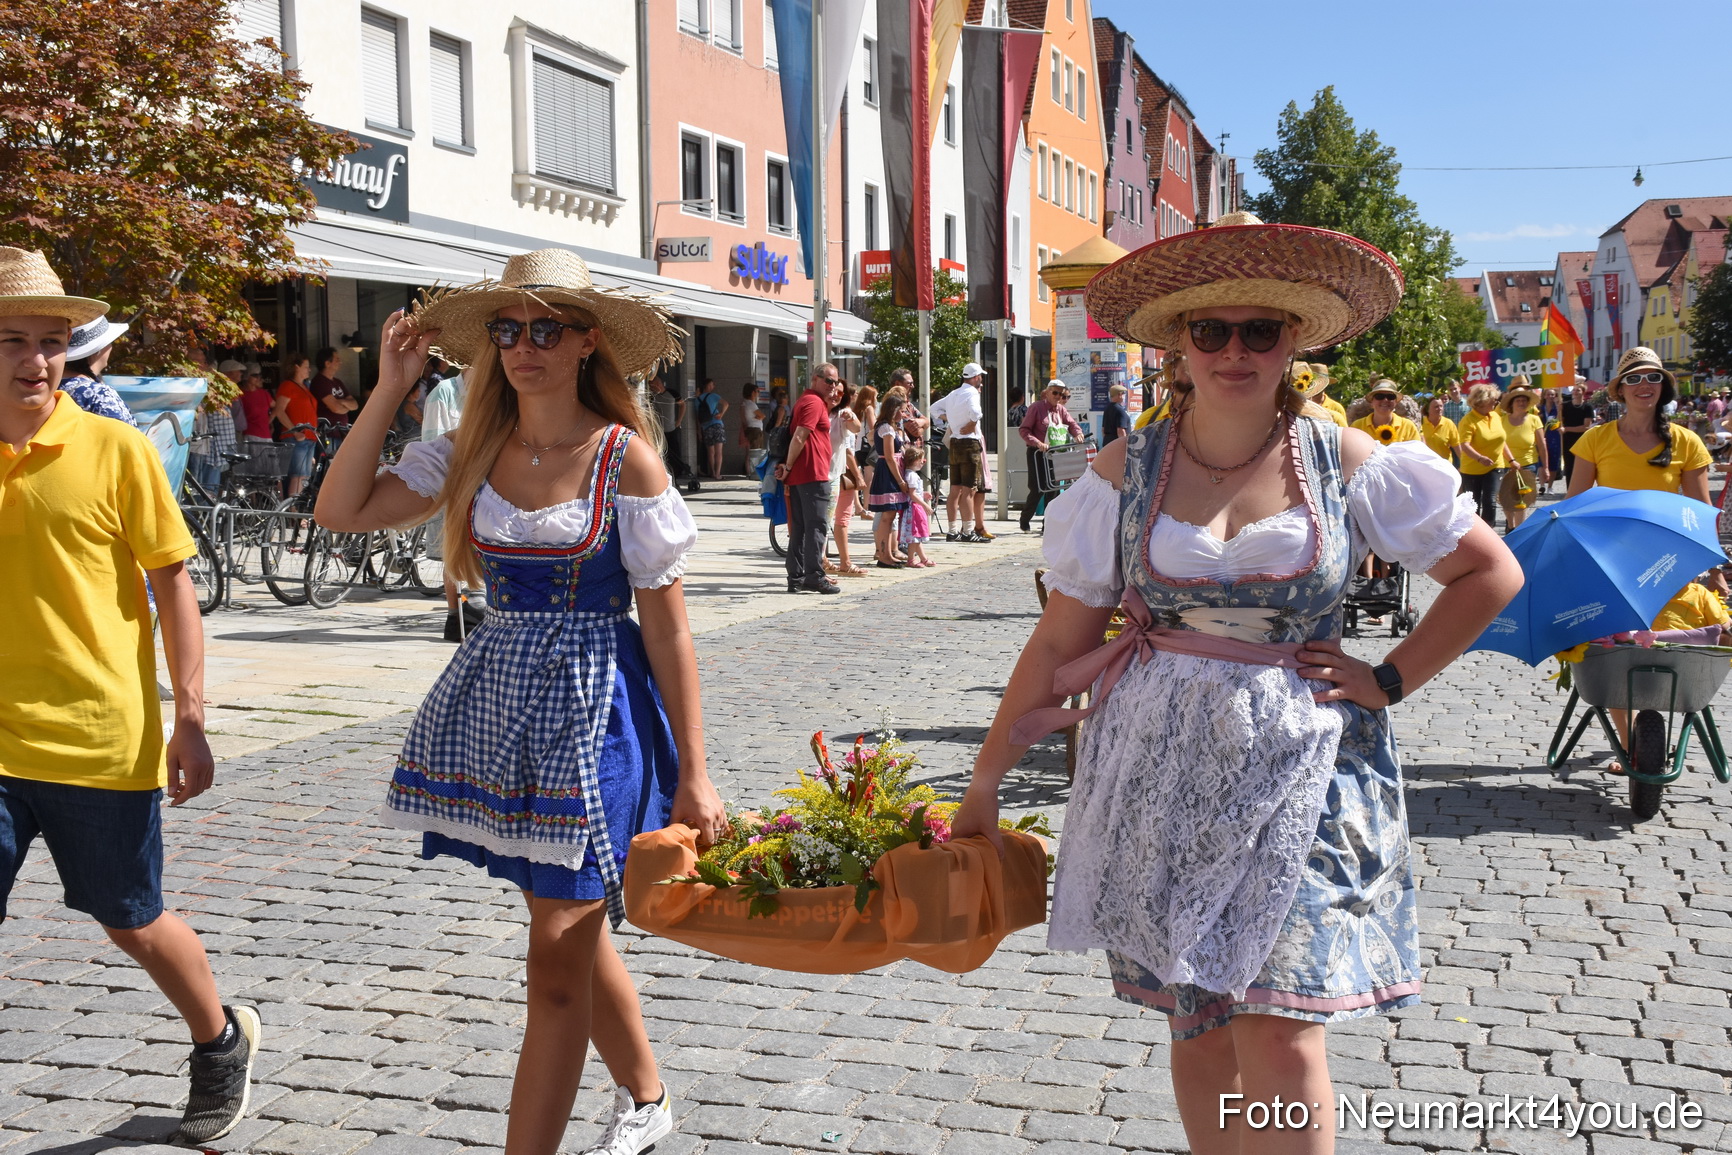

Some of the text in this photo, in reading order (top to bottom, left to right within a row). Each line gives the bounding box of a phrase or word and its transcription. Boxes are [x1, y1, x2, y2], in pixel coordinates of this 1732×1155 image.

[659, 241, 708, 257] sutor.
[736, 241, 789, 285] sutor.
[1495, 350, 1564, 385] Jugend
